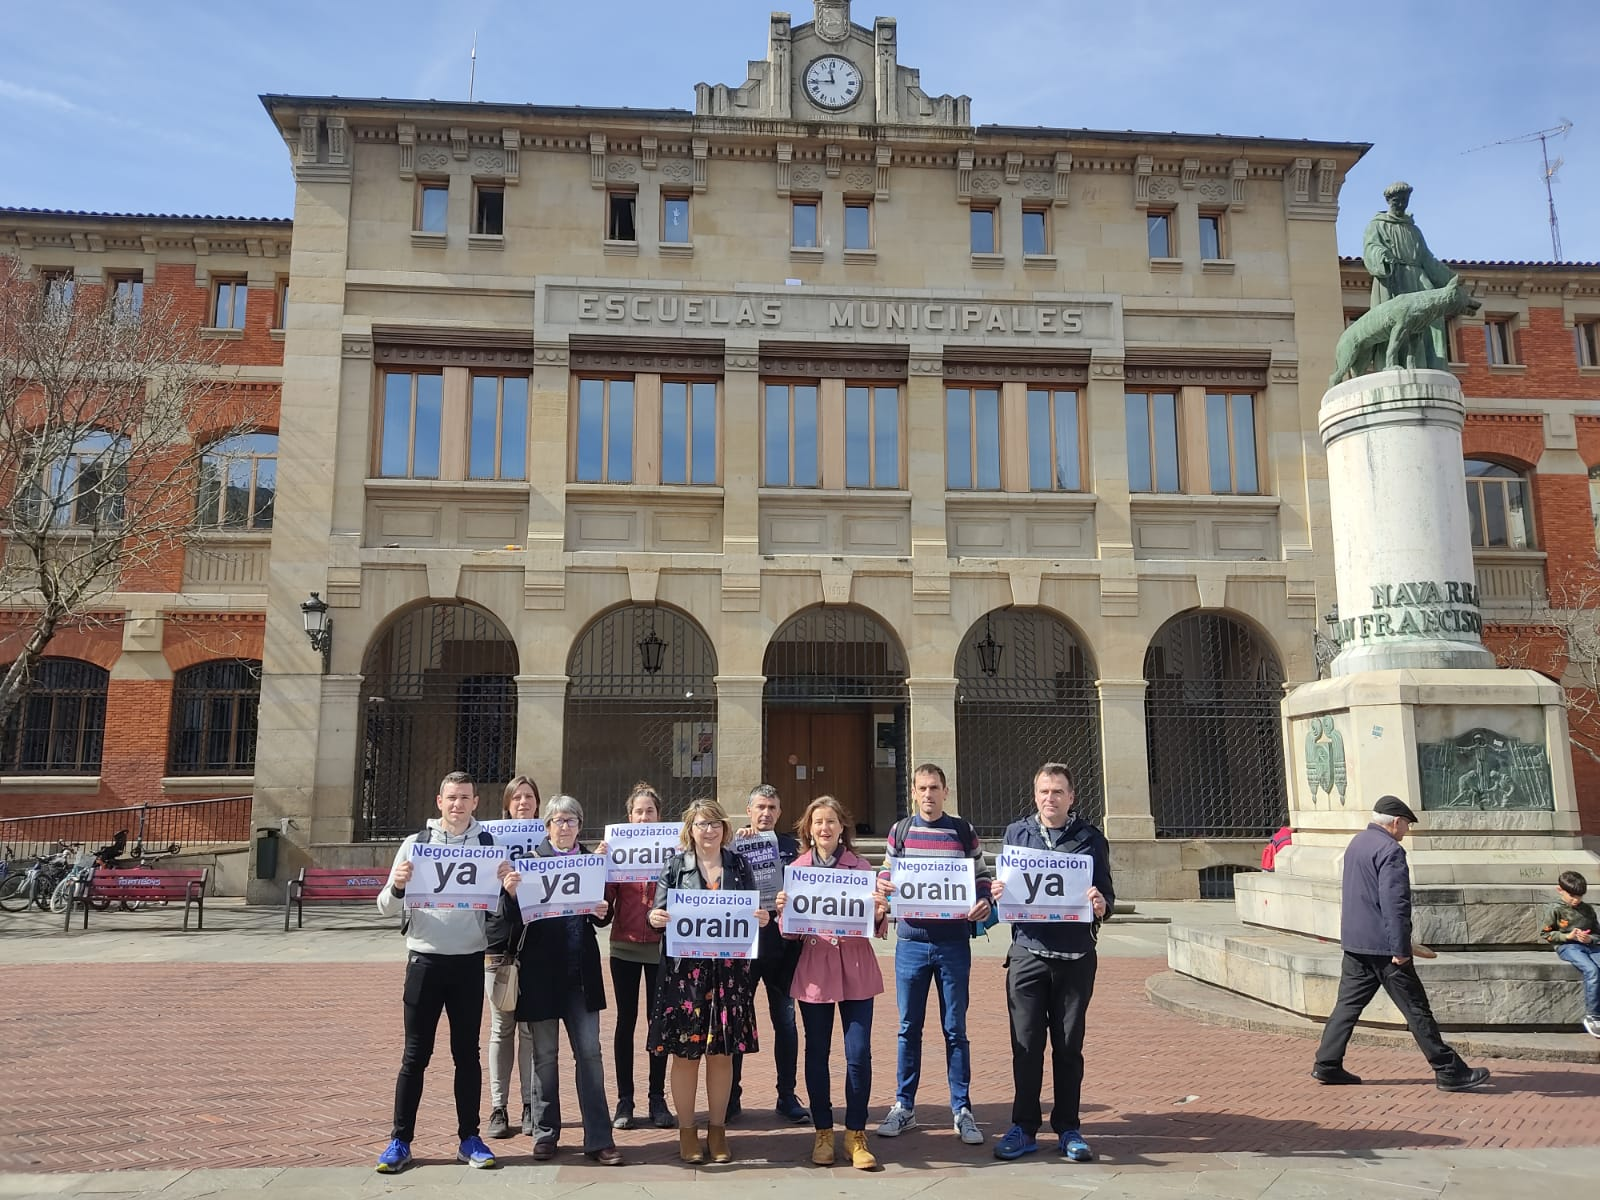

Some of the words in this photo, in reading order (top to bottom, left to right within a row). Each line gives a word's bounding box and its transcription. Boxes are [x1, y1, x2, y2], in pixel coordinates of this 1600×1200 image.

[578, 294, 782, 326] ESCUELAS
[828, 302, 1083, 333] MUNICIPALES
[611, 826, 679, 838] Negoziazioa
[412, 844, 504, 860] Negociación
[612, 842, 676, 864] orain
[737, 841, 773, 852] GREBA
[518, 855, 604, 873] Negociación
[898, 862, 968, 873] Negoziazioa
[1001, 856, 1088, 870] Negociación
[434, 862, 478, 894] ya
[540, 872, 580, 904] ya
[792, 870, 868, 886] Negoziazioa
[1023, 872, 1064, 904] ya
[900, 878, 966, 900] orain
[675, 893, 752, 906] Negoziazioa
[792, 890, 864, 918] orain
[676, 912, 748, 938] orain
